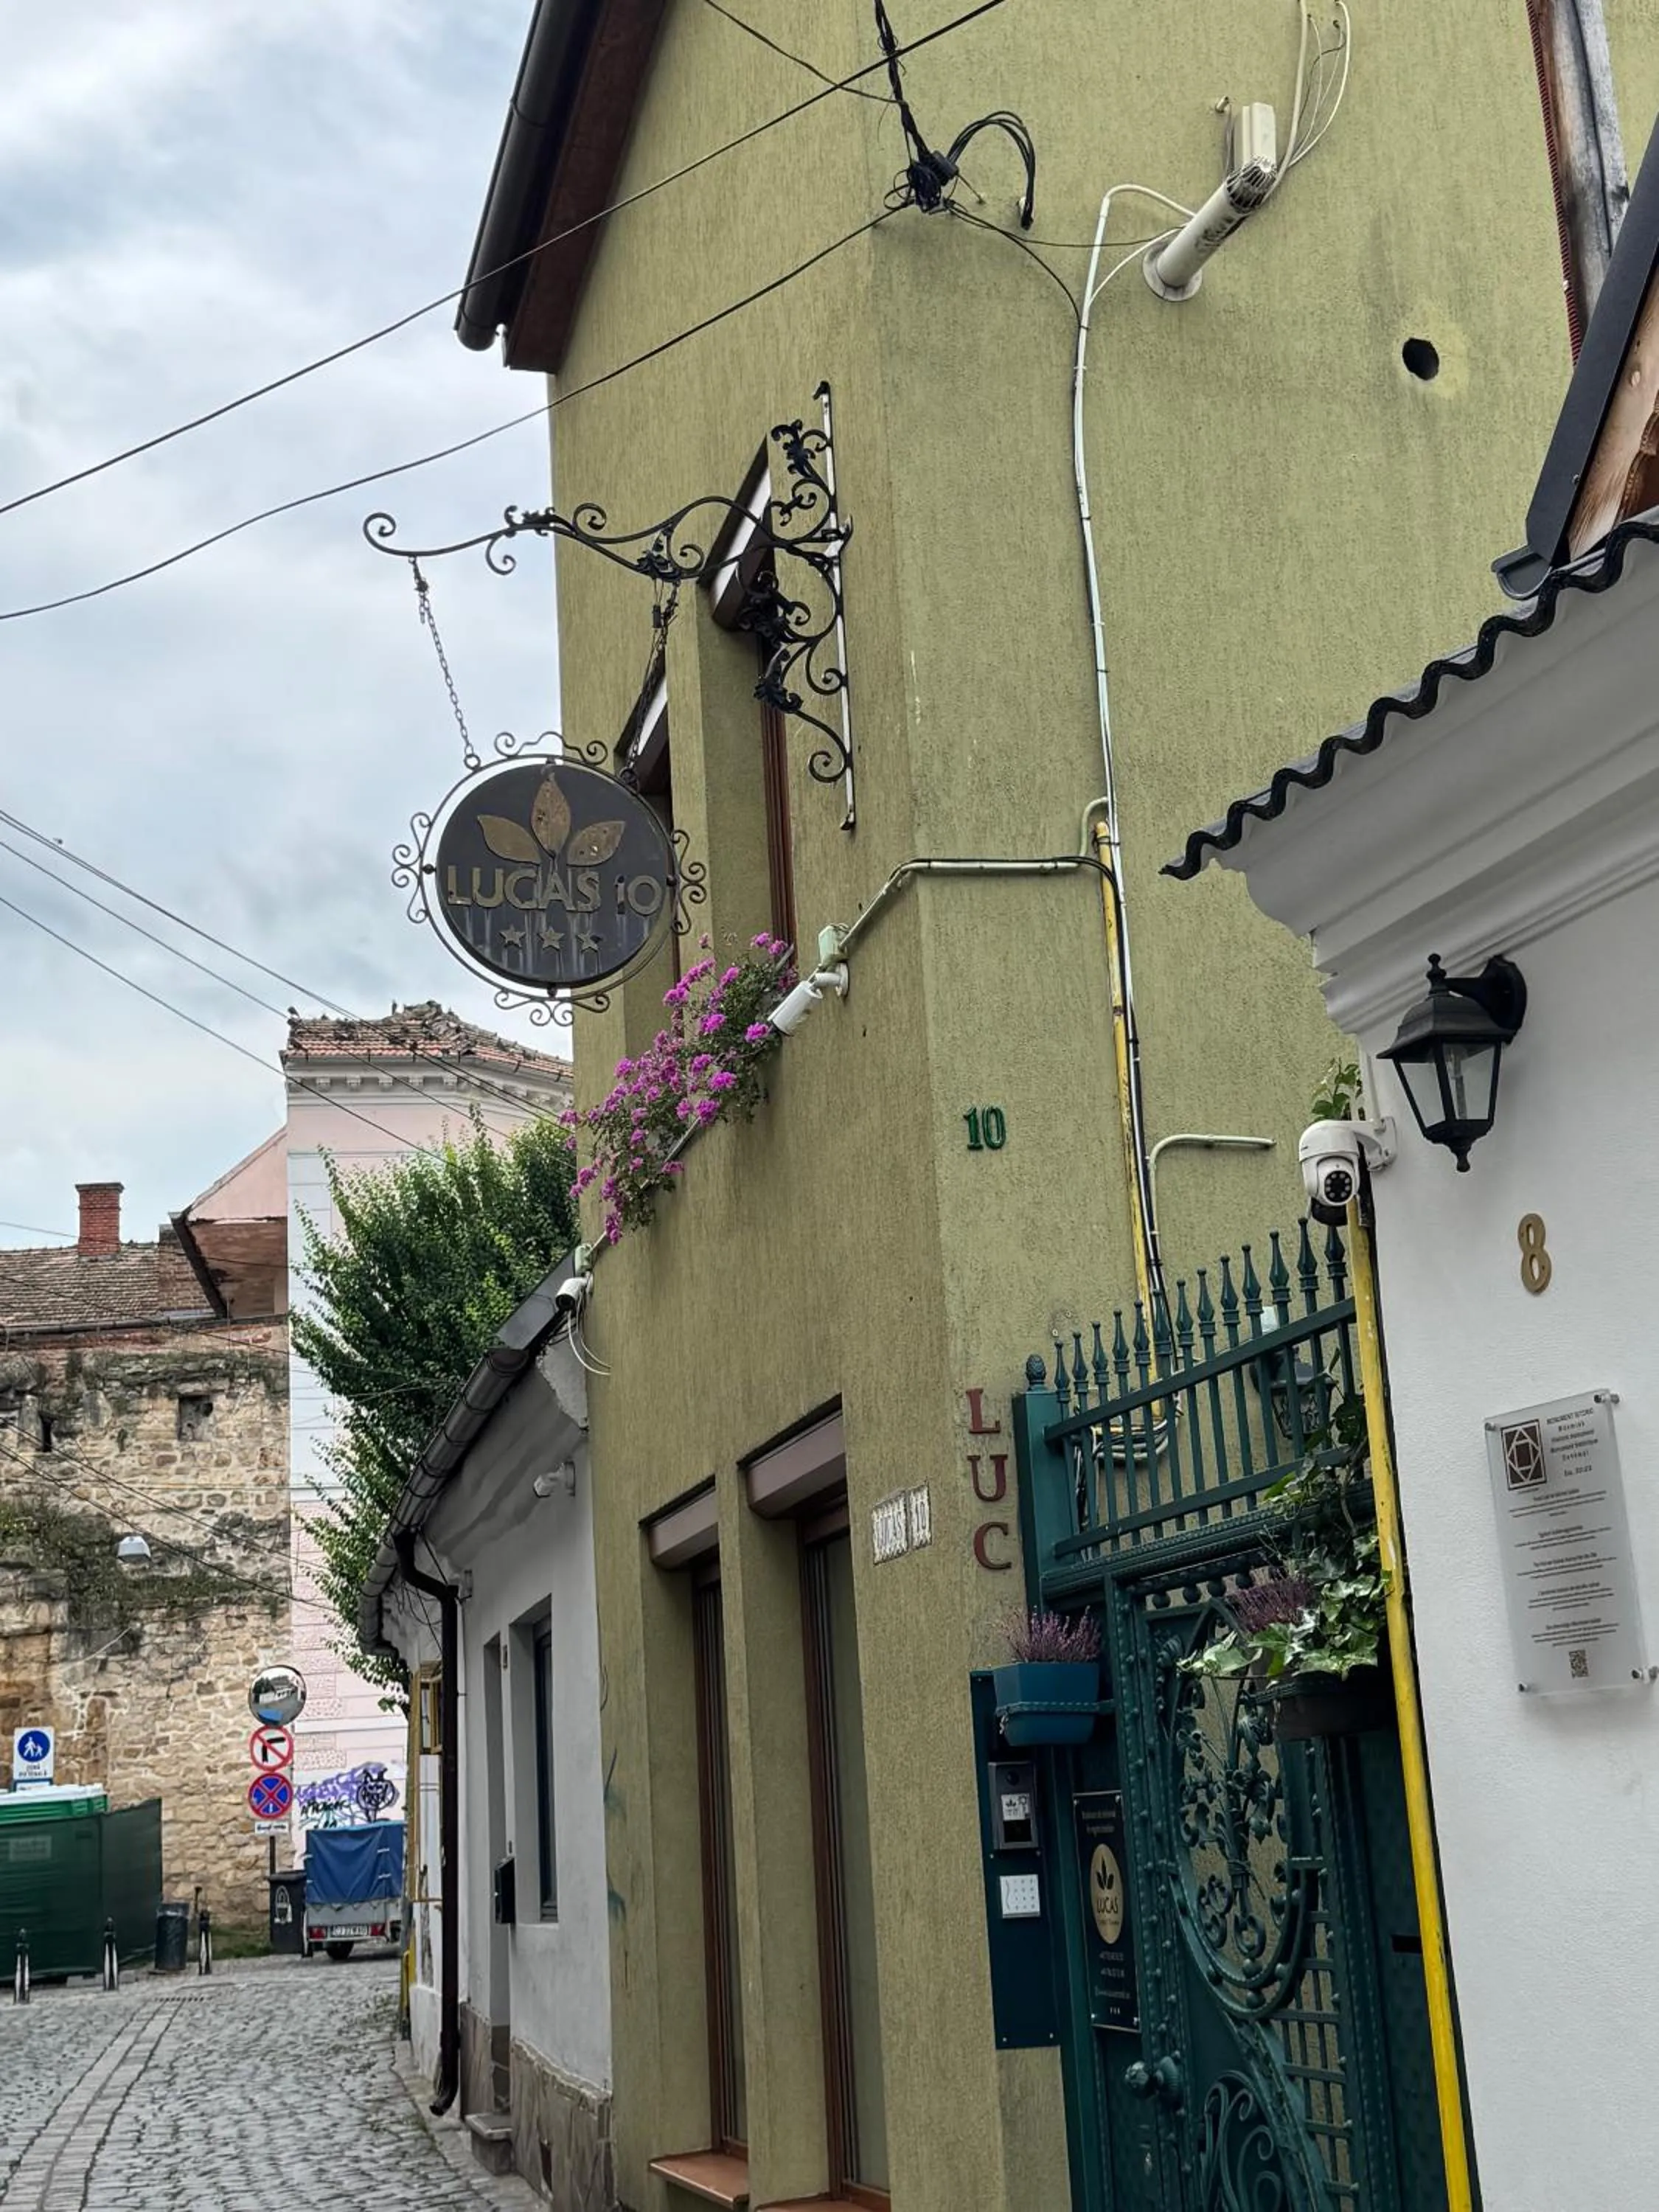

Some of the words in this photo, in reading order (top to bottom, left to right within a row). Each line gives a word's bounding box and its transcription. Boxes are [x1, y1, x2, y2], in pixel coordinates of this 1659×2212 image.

[447, 865, 602, 914] LUCAS
[963, 1107, 1006, 1150] 10
[1517, 1213, 1552, 1296] 8
[1096, 1896, 1119, 1915] LUCAS
